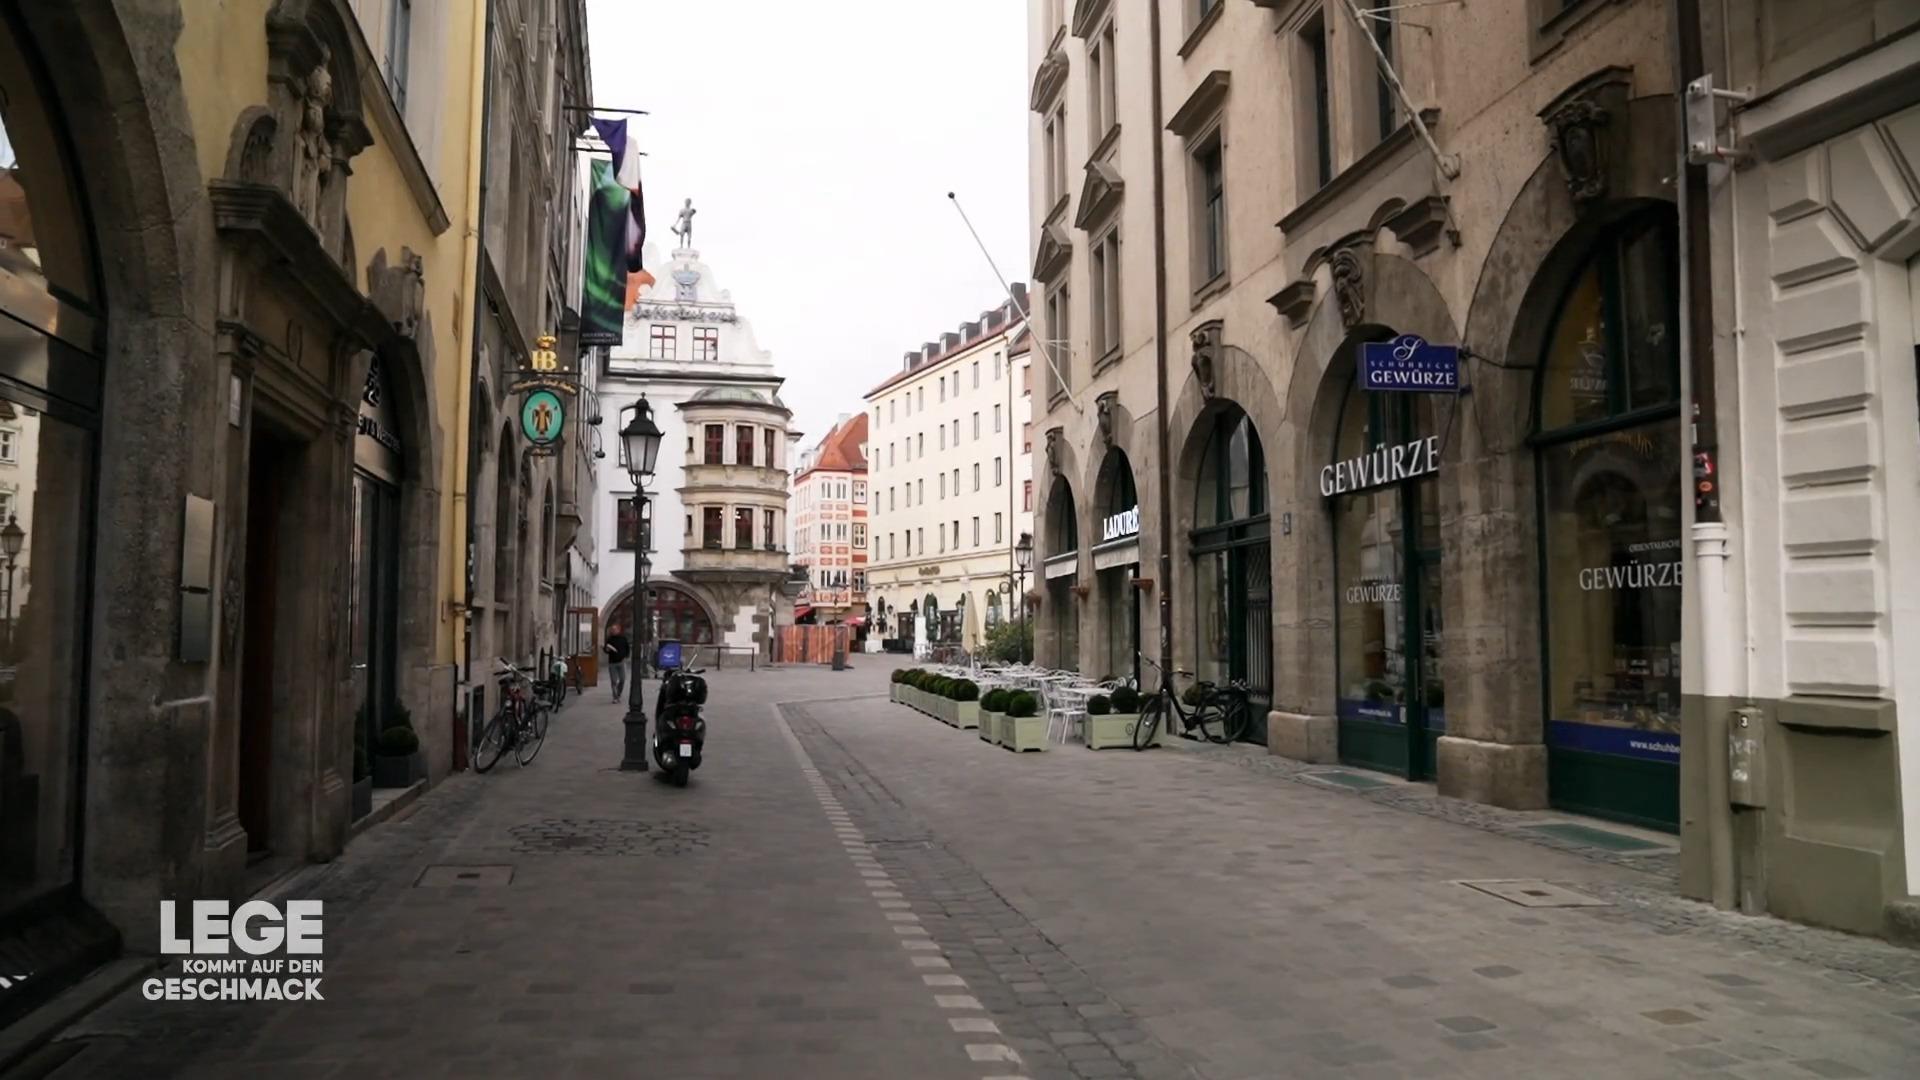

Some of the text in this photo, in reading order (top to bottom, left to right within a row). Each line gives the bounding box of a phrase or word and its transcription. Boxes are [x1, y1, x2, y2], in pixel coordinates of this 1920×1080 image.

[1371, 369, 1455, 385] GEWÜRZE
[1320, 435, 1438, 497] GEWÜRZE
[1579, 560, 1682, 590] GEWÜRZE
[1346, 582, 1401, 604] GEWÜRZE
